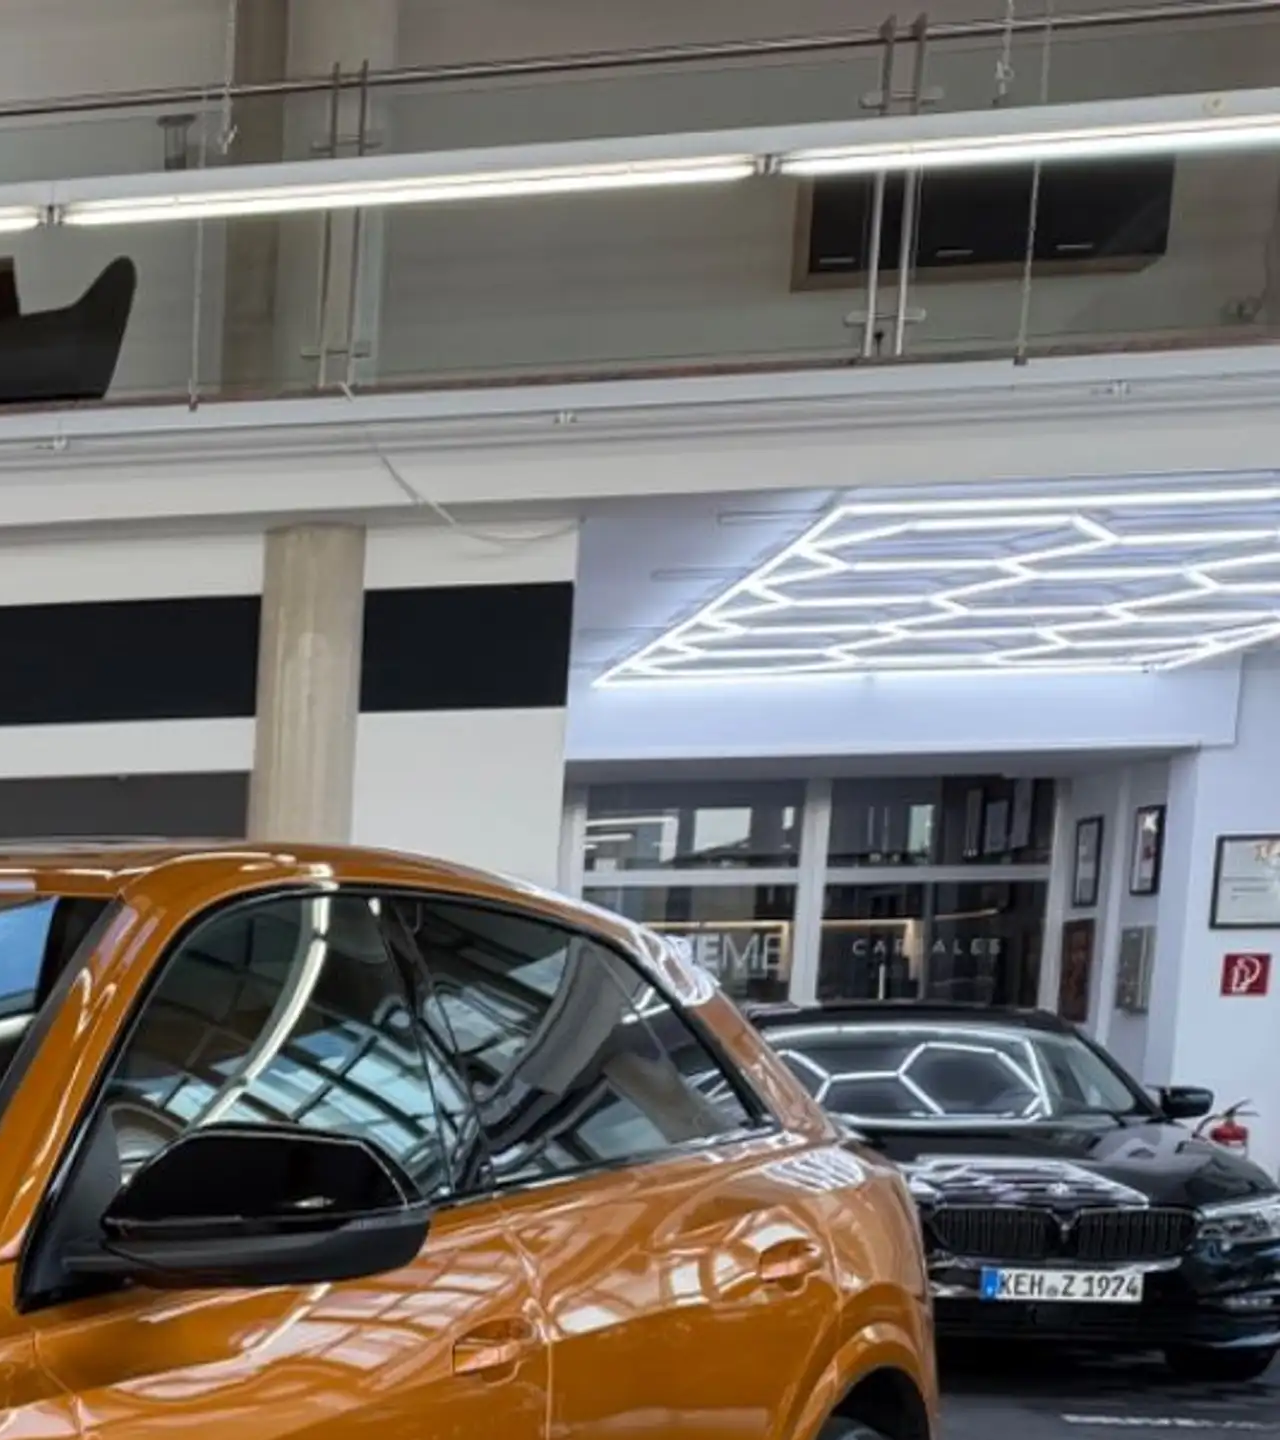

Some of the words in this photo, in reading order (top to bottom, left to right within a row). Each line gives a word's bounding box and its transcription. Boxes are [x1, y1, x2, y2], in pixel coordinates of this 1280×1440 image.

[999, 1272, 1044, 1298] KEH
[1060, 1273, 1076, 1298] Z
[1083, 1273, 1139, 1298] 1974
